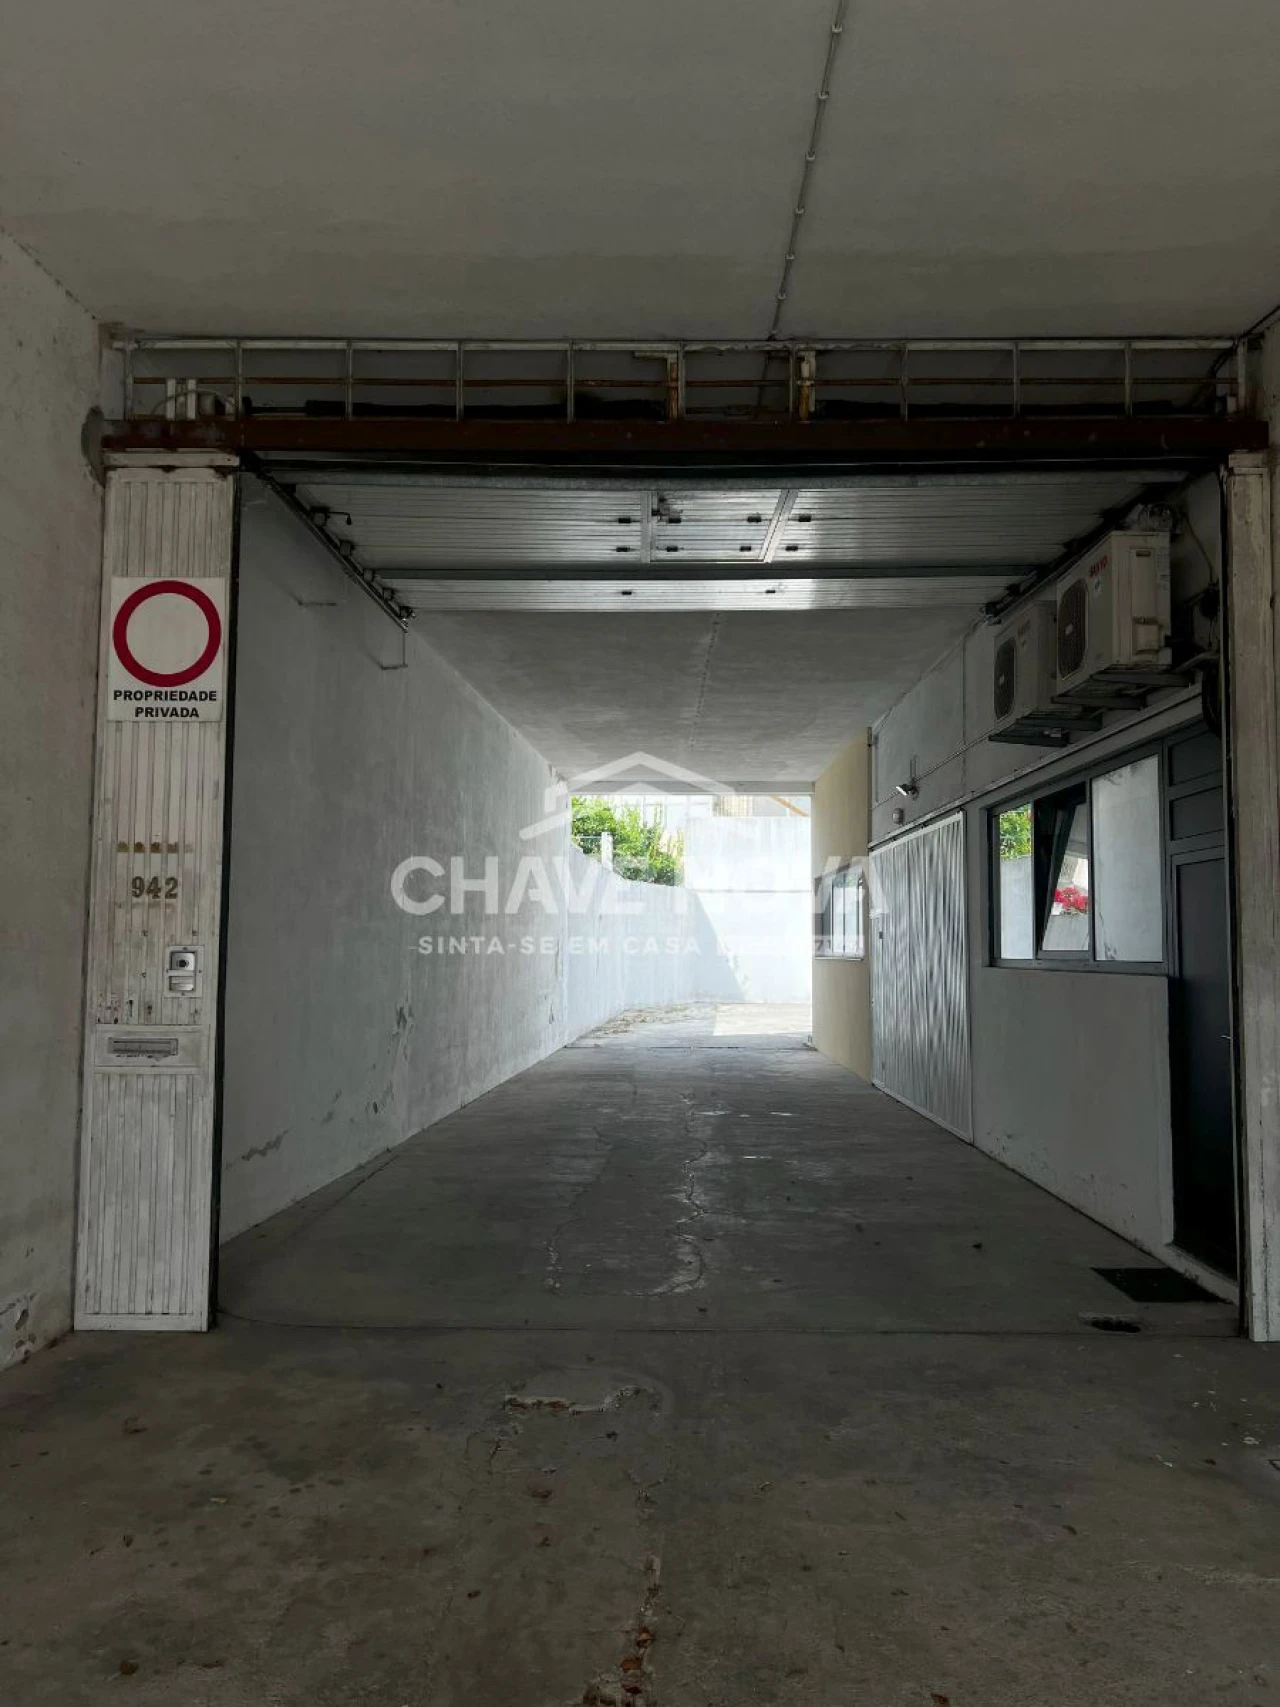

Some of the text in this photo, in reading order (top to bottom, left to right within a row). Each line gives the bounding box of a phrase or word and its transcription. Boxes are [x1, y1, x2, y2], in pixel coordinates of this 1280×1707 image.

[114, 690, 217, 702] PROPRIEDADE
[135, 707, 200, 718] PRIVADA
[131, 875, 179, 900] 942
